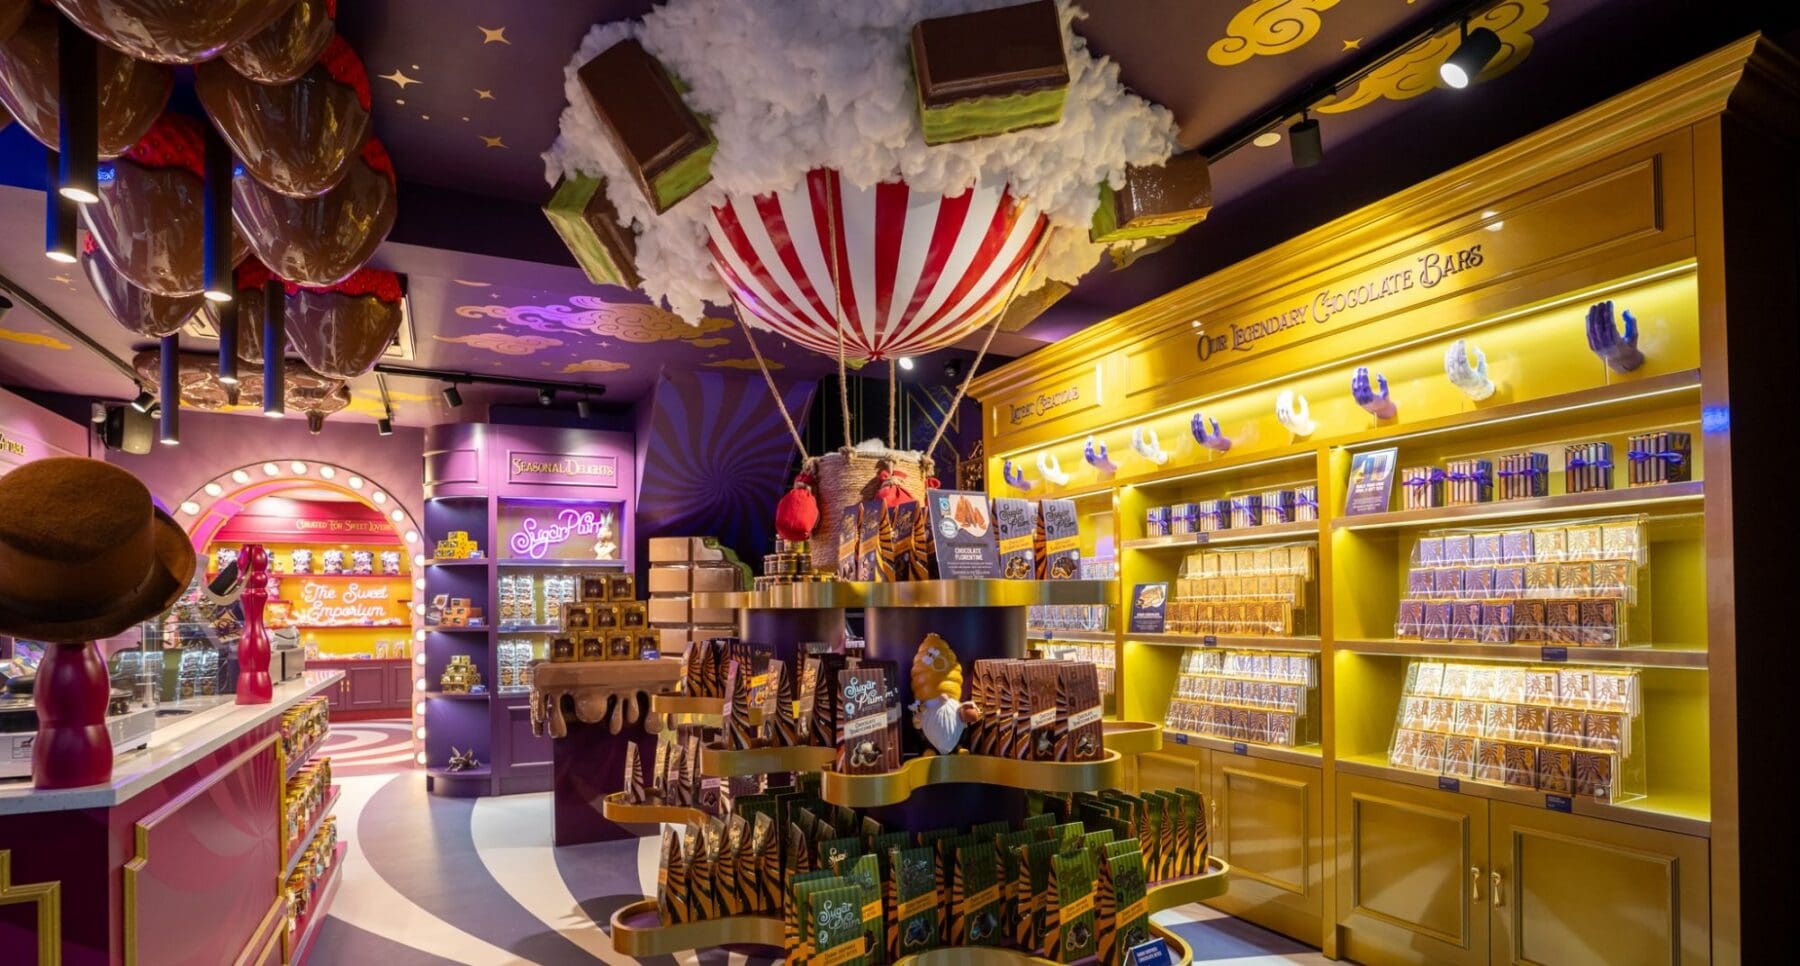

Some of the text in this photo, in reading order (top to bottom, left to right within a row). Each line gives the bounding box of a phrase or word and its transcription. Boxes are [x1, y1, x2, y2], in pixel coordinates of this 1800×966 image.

[1196, 244, 1485, 362] OUR LEGENDARY CHOCOLATE BARS
[511, 458, 565, 476] SEASONAL
[510, 517, 570, 560] Sugar
[303, 582, 388, 604] The Sweet
[306, 600, 385, 621] Emporium
[844, 676, 877, 699] Sugar
[855, 689, 883, 710] Plum
[817, 899, 854, 927] Sugar
